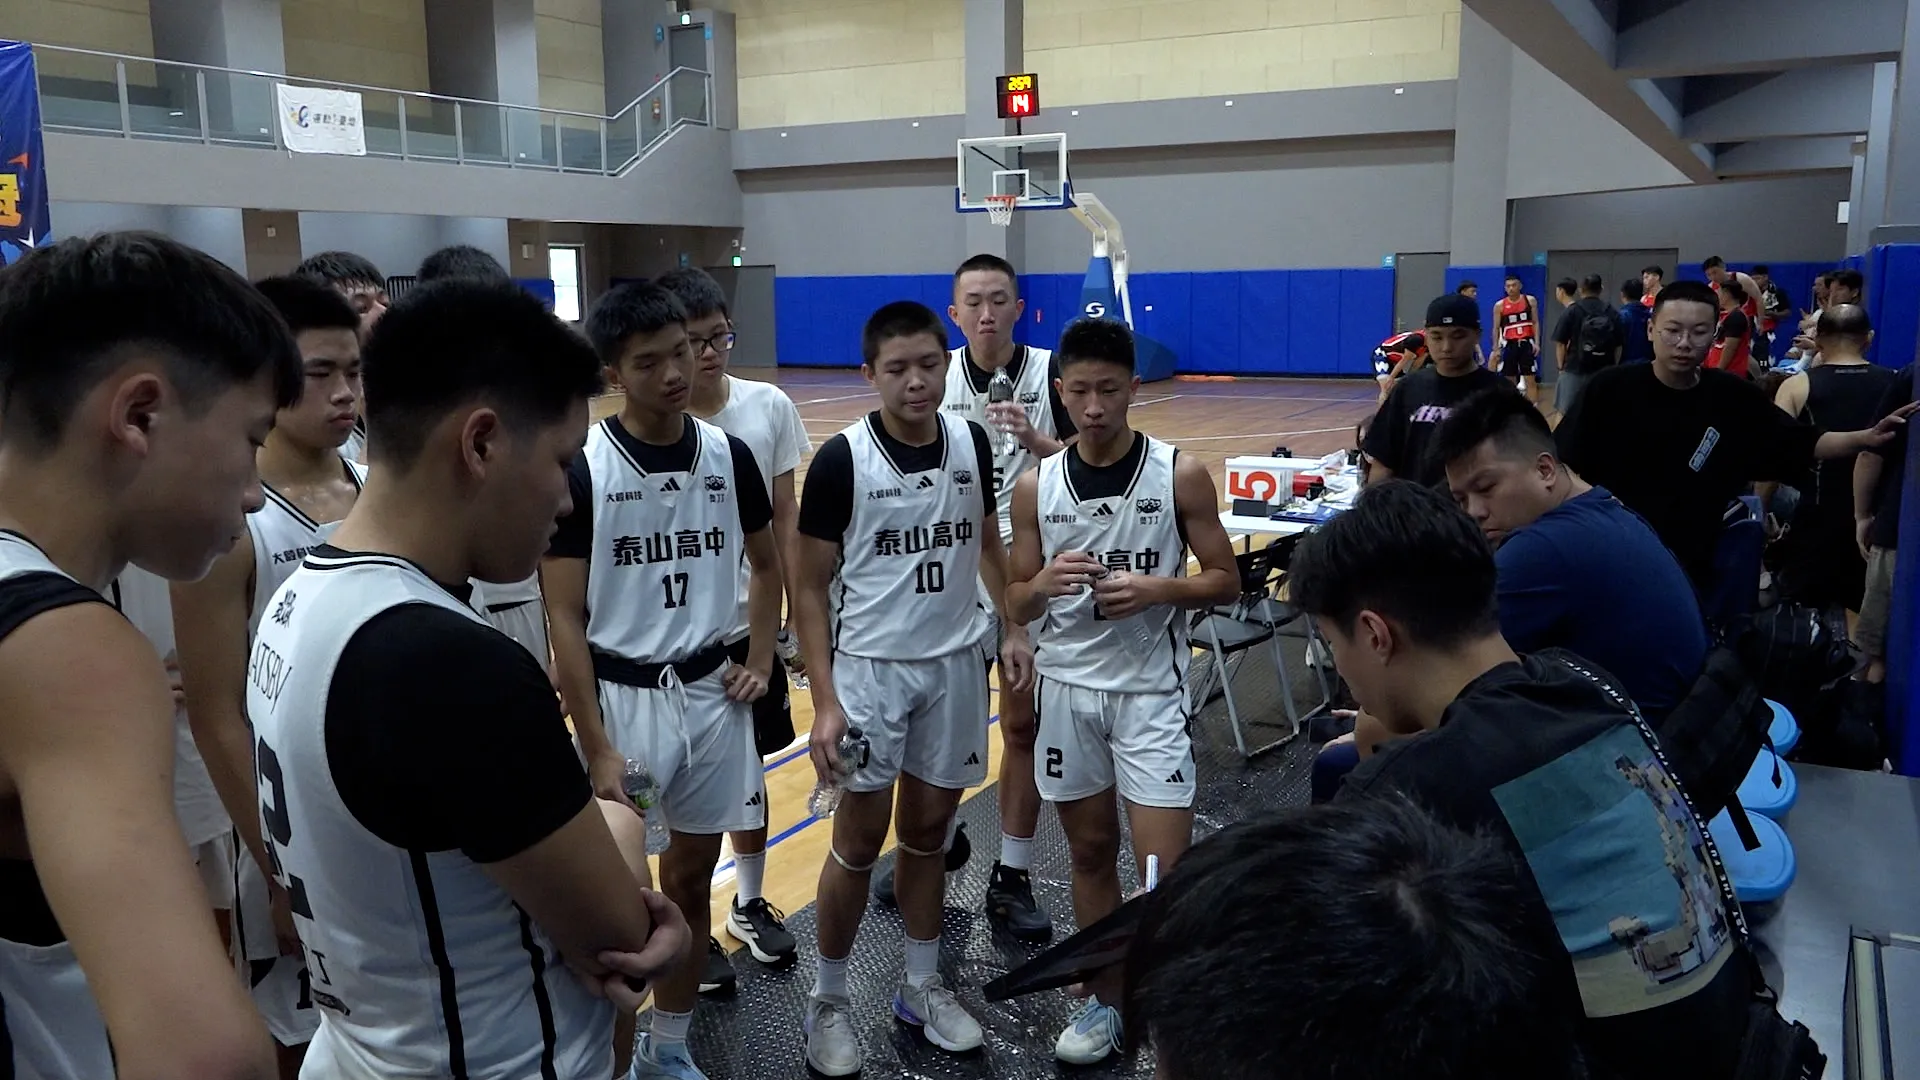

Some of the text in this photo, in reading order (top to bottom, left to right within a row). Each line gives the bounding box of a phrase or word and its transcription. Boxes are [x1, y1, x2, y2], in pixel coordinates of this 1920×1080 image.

[1012, 94, 1029, 113] 14
[1229, 471, 1277, 502] 5
[612, 526, 725, 567] 泰山高中
[874, 518, 973, 556] 泰山高中
[661, 572, 689, 609] 17
[915, 561, 944, 594] 10
[1046, 747, 1063, 779] 2
